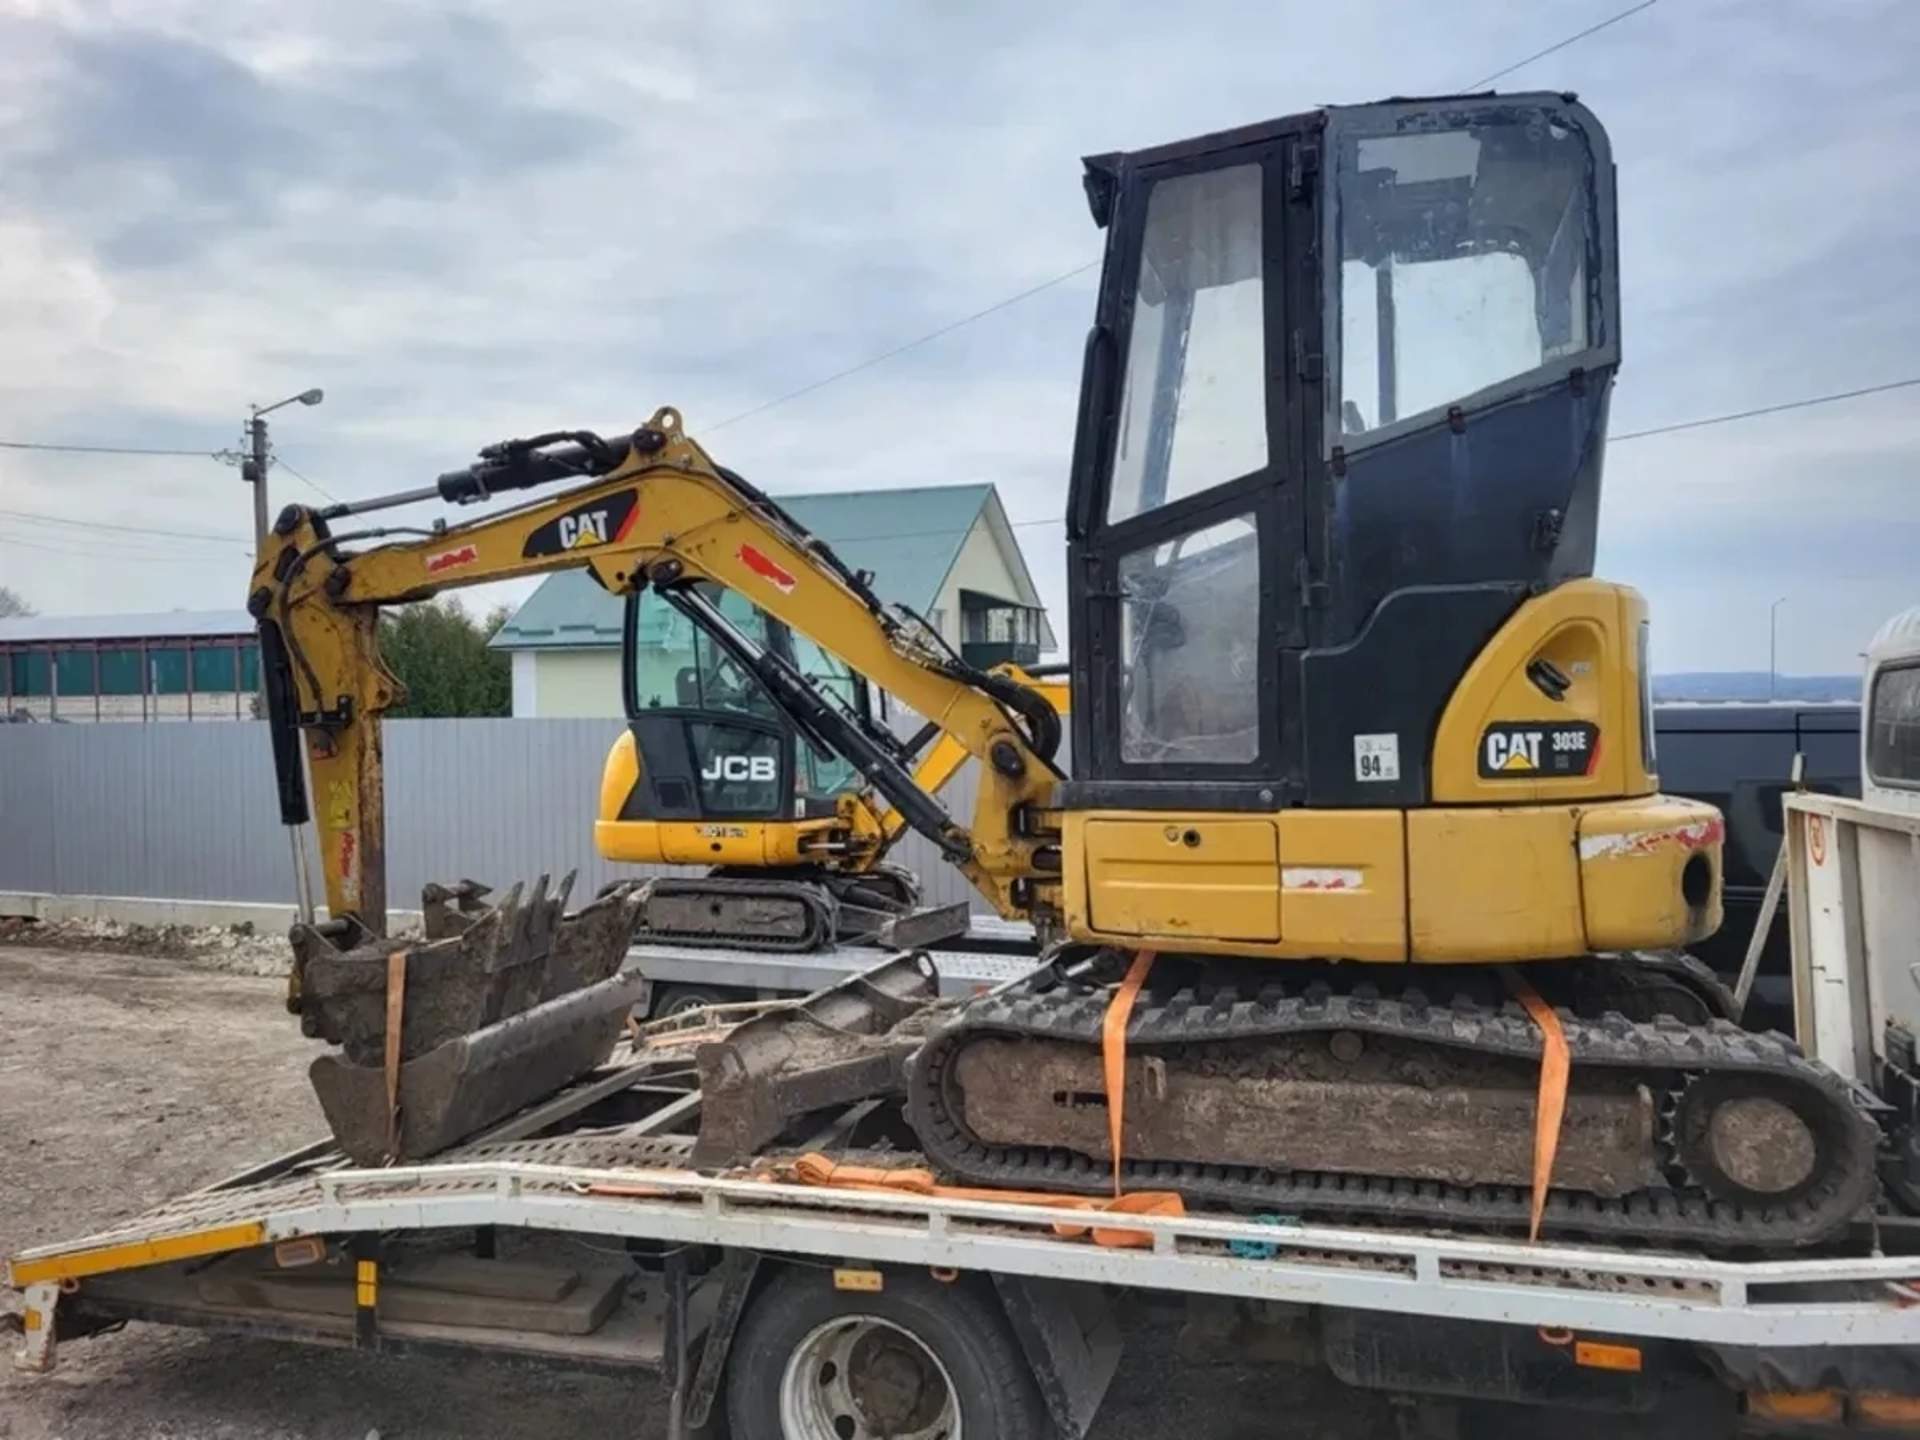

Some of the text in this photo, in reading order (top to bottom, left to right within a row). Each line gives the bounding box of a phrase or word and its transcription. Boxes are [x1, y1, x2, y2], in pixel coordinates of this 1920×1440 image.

[559, 510, 608, 549] CAT
[1361, 755, 1380, 777] 94
[1487, 732, 1543, 770] CAT
[1552, 731, 1587, 751] 303E
[701, 755, 776, 781] JCB
